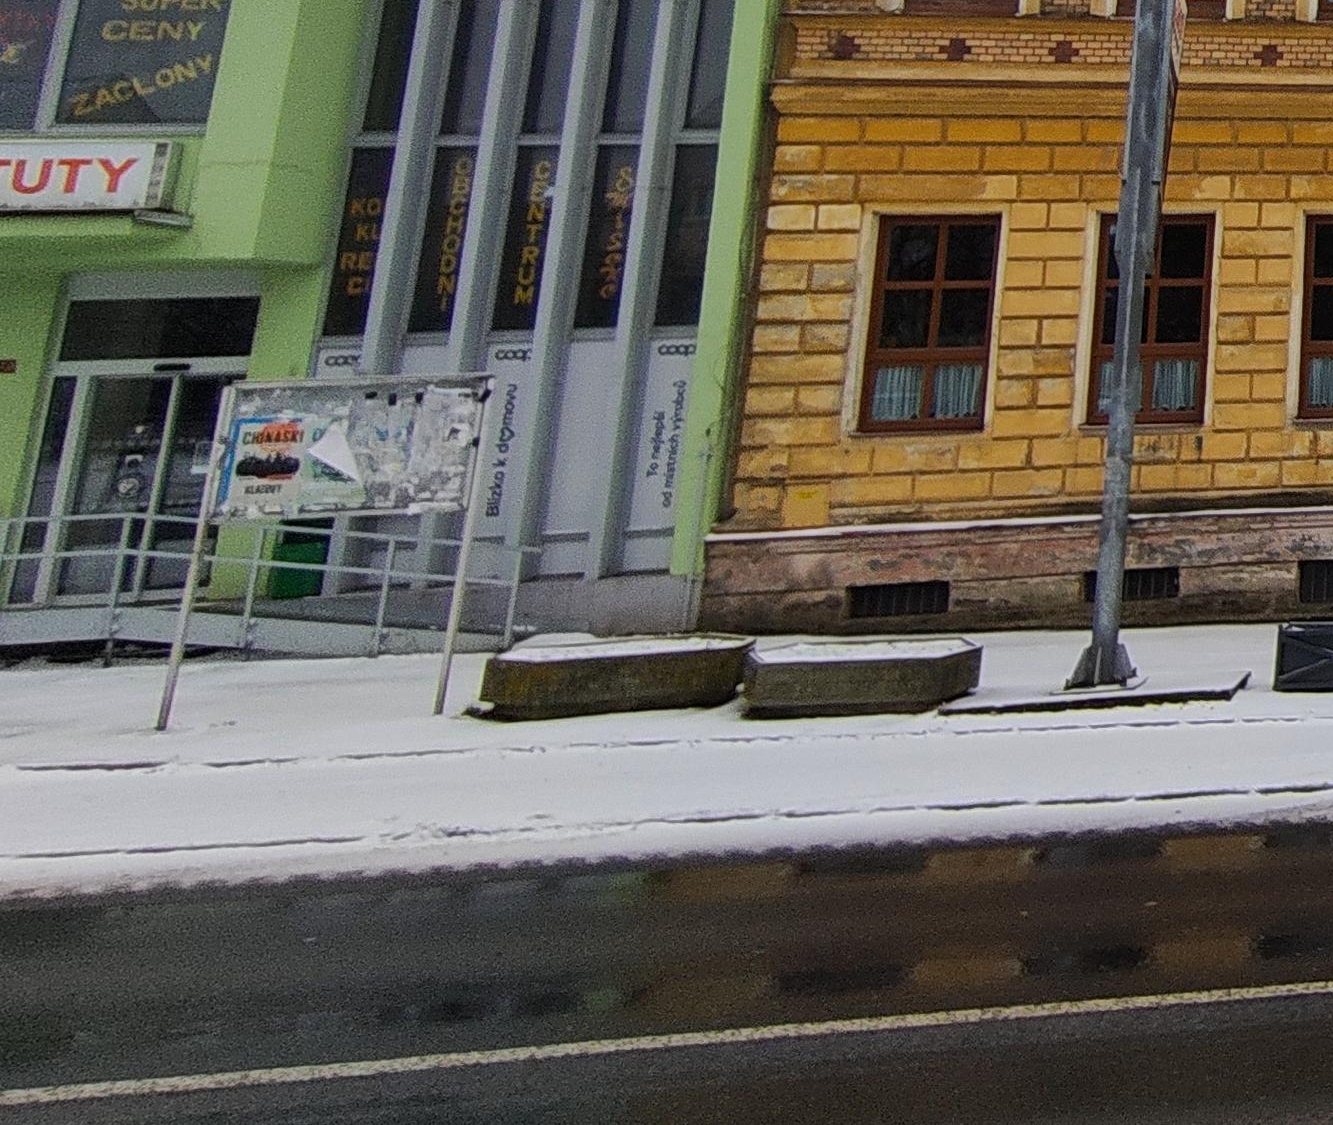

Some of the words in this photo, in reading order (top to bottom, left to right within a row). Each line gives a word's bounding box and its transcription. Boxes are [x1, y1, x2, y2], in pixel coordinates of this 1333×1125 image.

[101, 19, 206, 42] CENY
[68, 53, 213, 116] ZACLONY
[513, 160, 551, 305] CENTRUM
